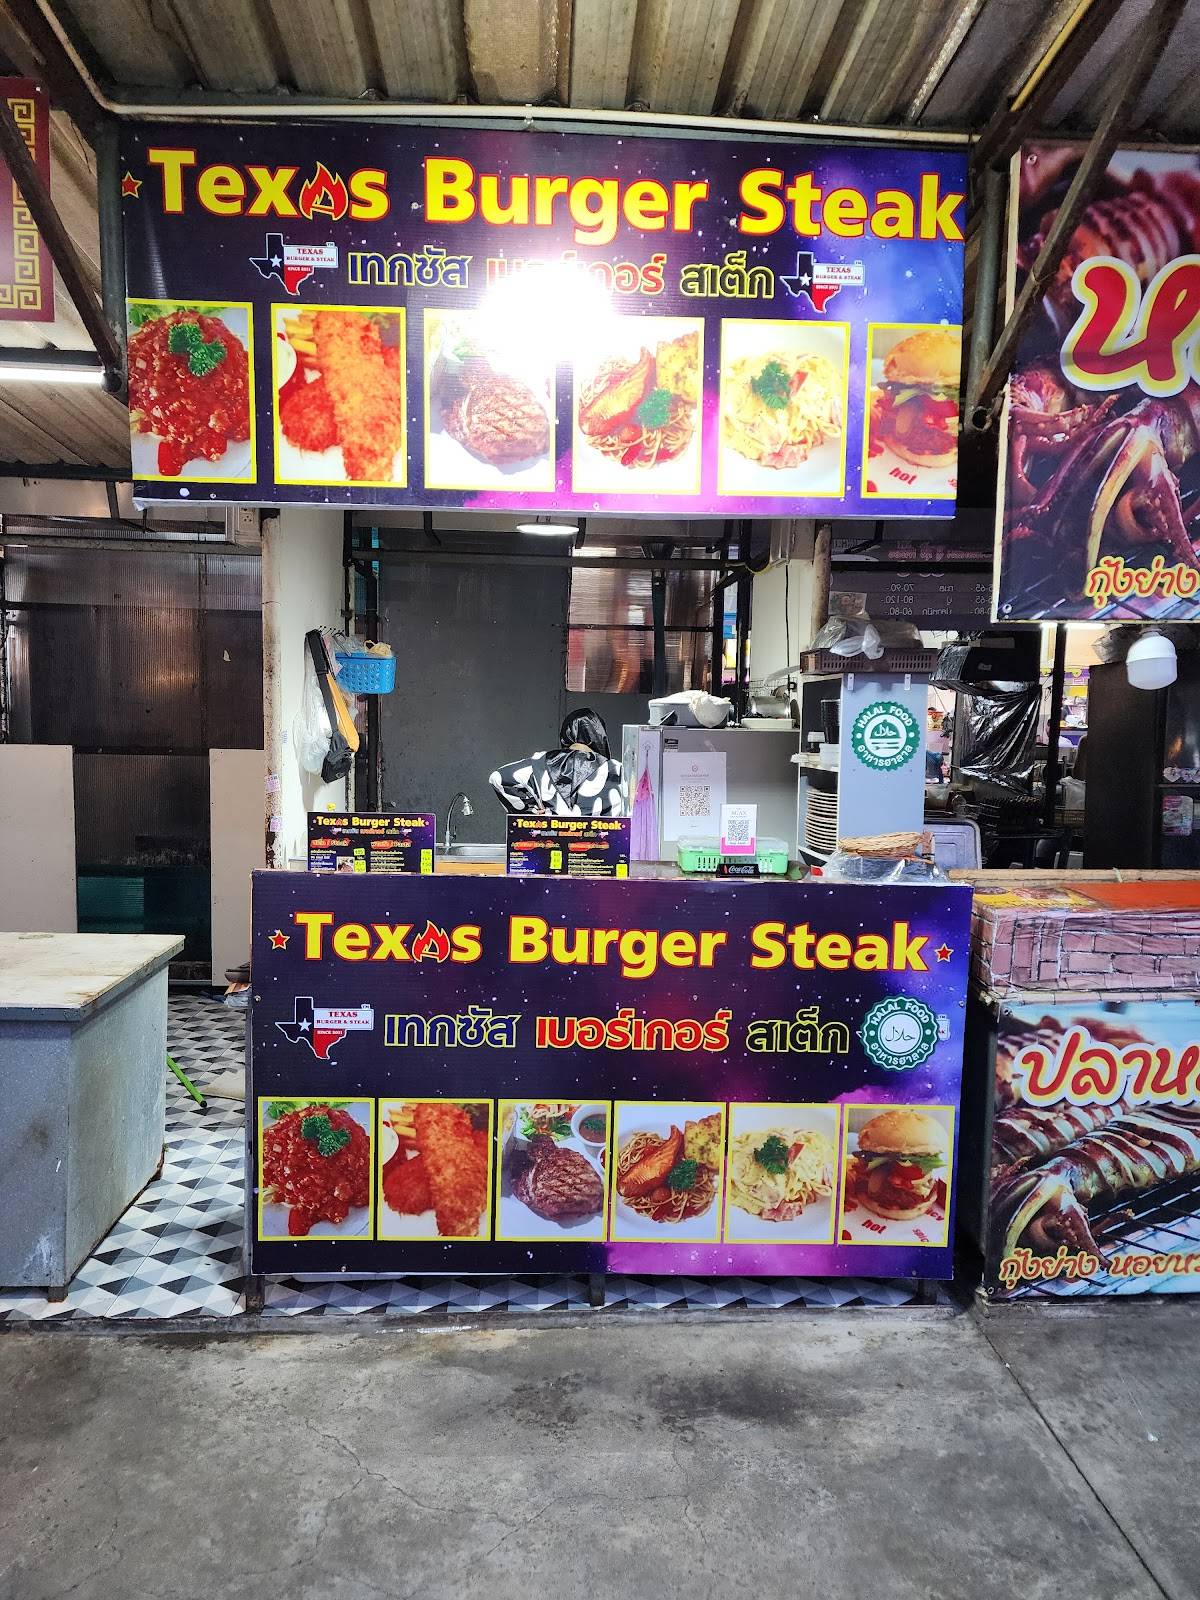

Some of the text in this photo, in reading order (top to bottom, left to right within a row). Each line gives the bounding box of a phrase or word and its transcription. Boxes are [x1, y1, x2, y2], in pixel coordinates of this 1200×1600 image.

[424, 156, 709, 246] Burger
[739, 168, 967, 242] Steak
[347, 245, 473, 288] เทกซัส
[680, 250, 775, 299] สเต็ก
[1064, 257, 1200, 393] ห
[889, 467, 917, 485] hot
[1085, 555, 1200, 609] กุ้งย่าง
[857, 705, 913, 728] HALAL FOOD
[857, 744, 913, 767] อาหารฮาลาล
[351, 816, 391, 828] Burger
[393, 817, 426, 827] Steak
[550, 819, 588, 831] Burger
[591, 820, 622, 830] Steak
[508, 914, 728, 980] Burger
[751, 919, 930, 973] Steak
[384, 1005, 850, 1053] เทกซัส เบอร์เกอร์ สเต็ก
[870, 1002, 930, 1026] HALAL FOOD
[870, 1042, 930, 1065] อาหารฮาลาล
[1018, 1029, 1200, 1100] ปลาห
[862, 1219, 887, 1234] hot
[999, 1245, 1099, 1290] กุ้งย่าง
